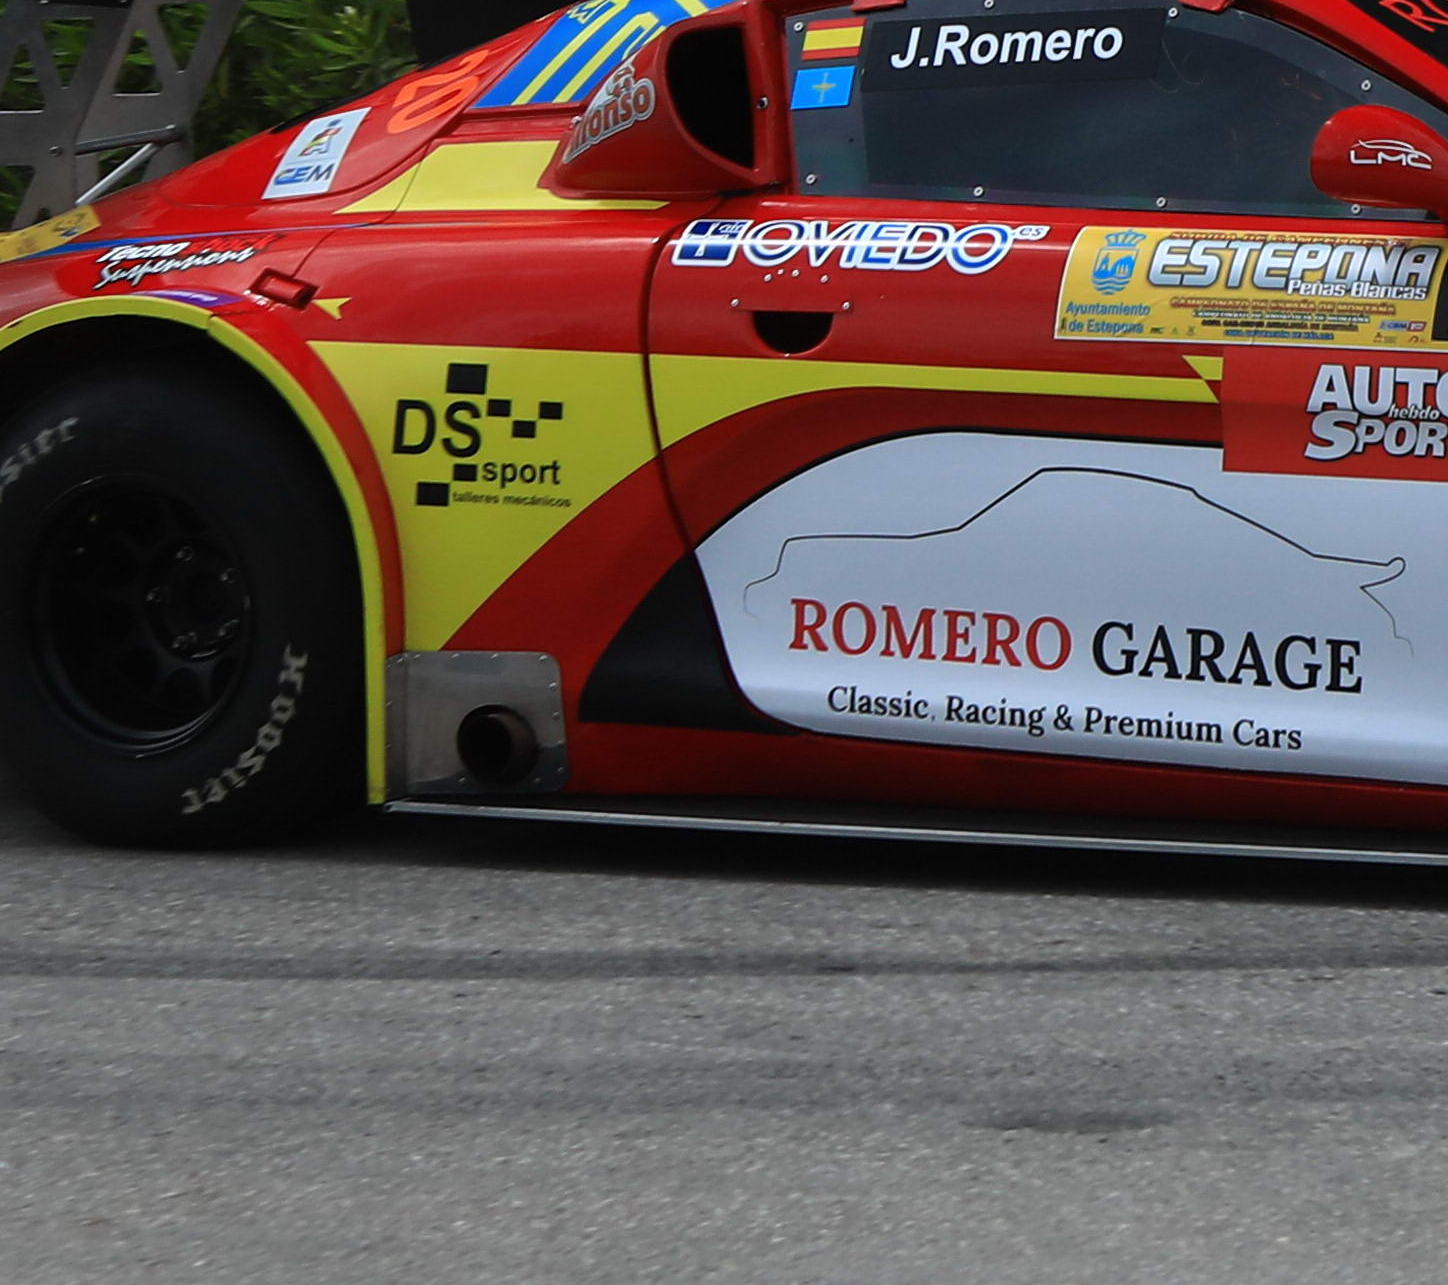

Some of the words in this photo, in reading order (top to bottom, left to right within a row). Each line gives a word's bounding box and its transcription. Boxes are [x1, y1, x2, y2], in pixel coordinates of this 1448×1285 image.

[890, 23, 1124, 70] J.Romero
[386, 49, 490, 135] 20
[1349, 148, 1433, 171] LMC
[272, 162, 336, 187] CEM
[95, 241, 192, 264] Tecno
[1147, 237, 1443, 290] ESTEPONA
[92, 246, 255, 291] Suspensions
[1287, 278, 1347, 298] Peñas
[1351, 280, 1429, 301] Blancas
[1065, 300, 1151, 318] Ayuntamiento
[1068, 319, 1084, 332] de
[1086, 318, 1145, 335] Estepona
[1387, 402, 1441, 421] hebdo
[392, 398, 483, 459] DS
[481, 460, 562, 489] sport
[452, 491, 500, 504] talleres
[788, 597, 1073, 672] ROMERO
[1091, 620, 1363, 694] GARAGE
[943, 695, 1047, 738] Racing
[1052, 704, 1076, 732] &
[1083, 706, 1223, 744] Premium
[1232, 719, 1303, 751] Cars
